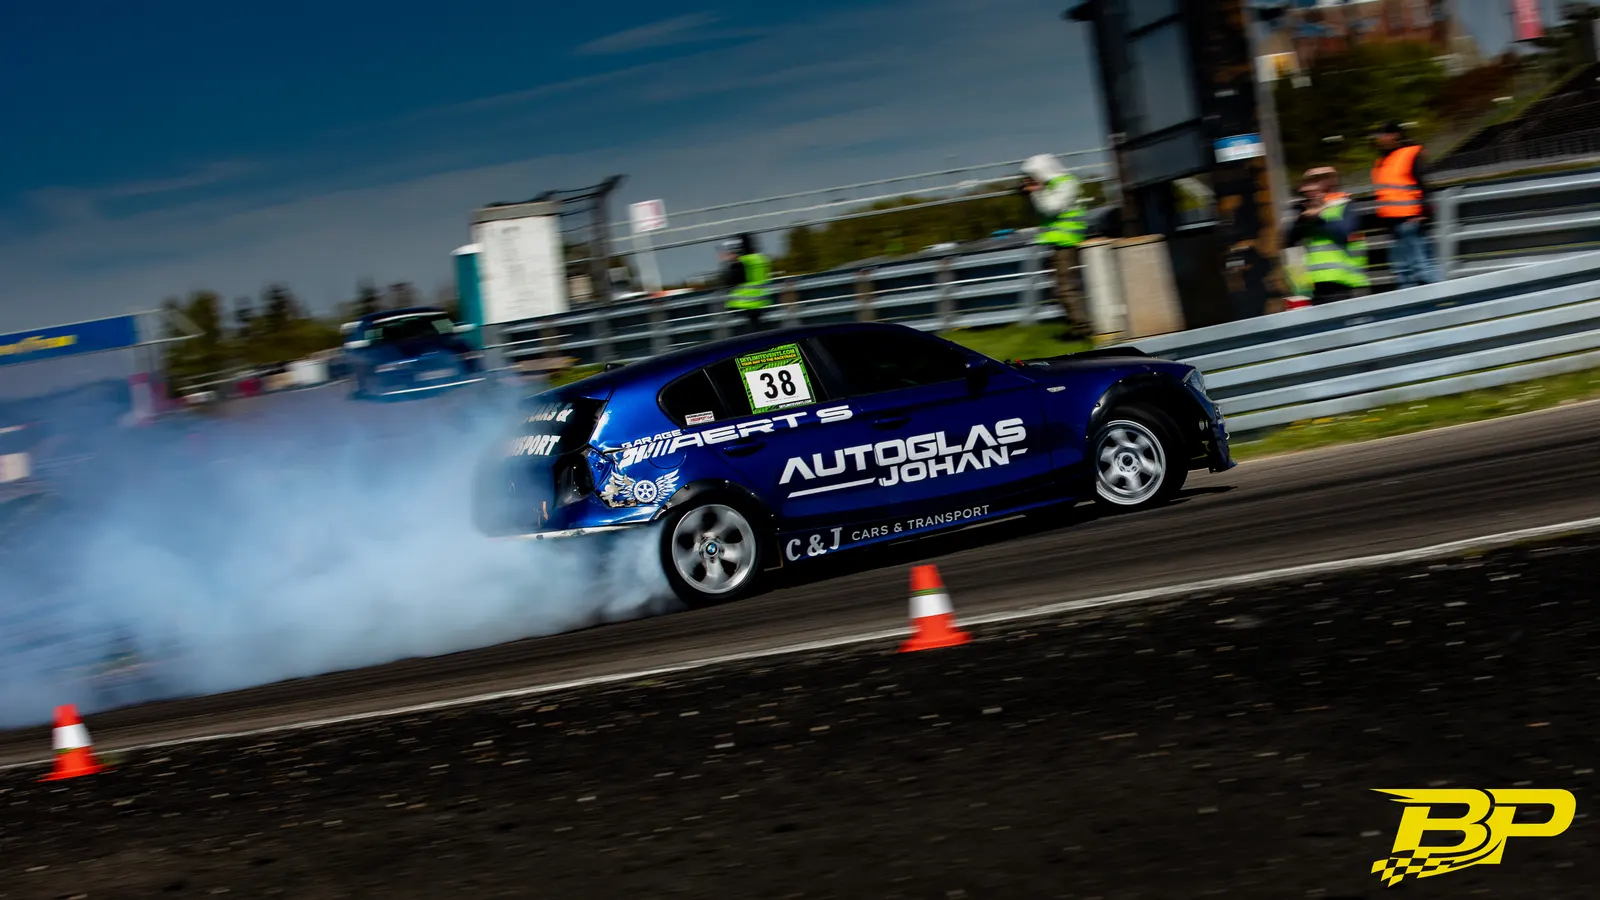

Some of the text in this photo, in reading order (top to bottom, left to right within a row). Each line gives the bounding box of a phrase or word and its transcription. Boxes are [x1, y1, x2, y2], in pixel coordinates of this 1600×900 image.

[759, 369, 796, 399] 38
[621, 429, 683, 449] GARAGE
[779, 417, 1027, 485] AUTOGLAS
[879, 446, 1010, 487] JOHAN
[786, 505, 990, 561] C & J CARS & TRANSPORT
